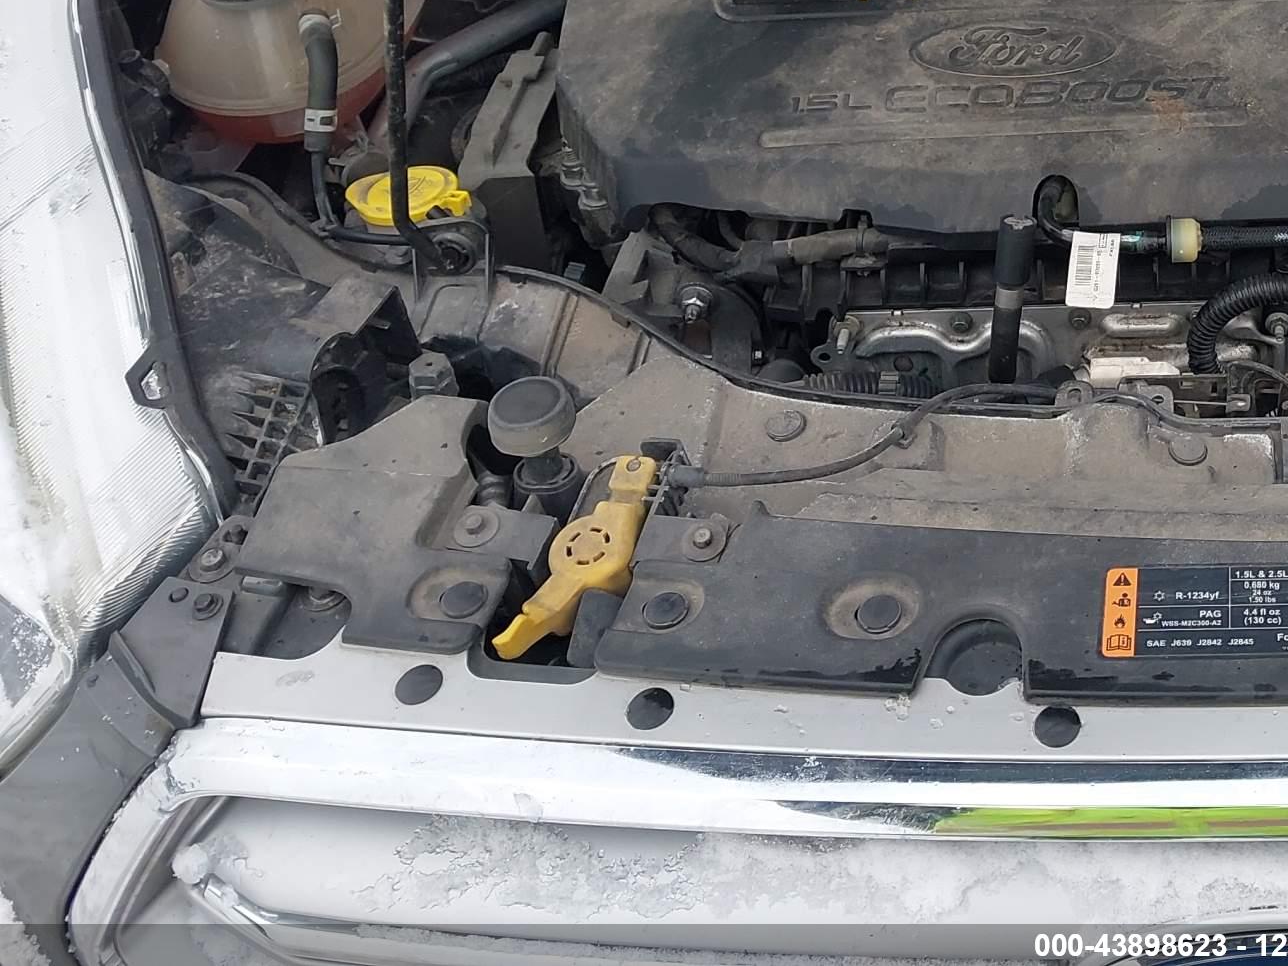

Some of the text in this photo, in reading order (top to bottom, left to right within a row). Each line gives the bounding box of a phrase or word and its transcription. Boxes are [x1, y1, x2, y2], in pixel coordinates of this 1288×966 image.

[948, 26, 1085, 70] Ford
[1235, 570, 1288, 579] 1.5L & 2.5L
[1243, 580, 1280, 590] 0.680 kg
[1175, 591, 1220, 601] R-1234yf
[1199, 610, 1222, 618] PAG
[1243, 608, 1258, 616] 4.4
[1259, 608, 1266, 616] fl
[1244, 616, 1282, 625] (130 cc)
[1146, 639, 1167, 647] SAE
[1170, 639, 1192, 647] J639
[1227, 638, 1254, 646] J2845
